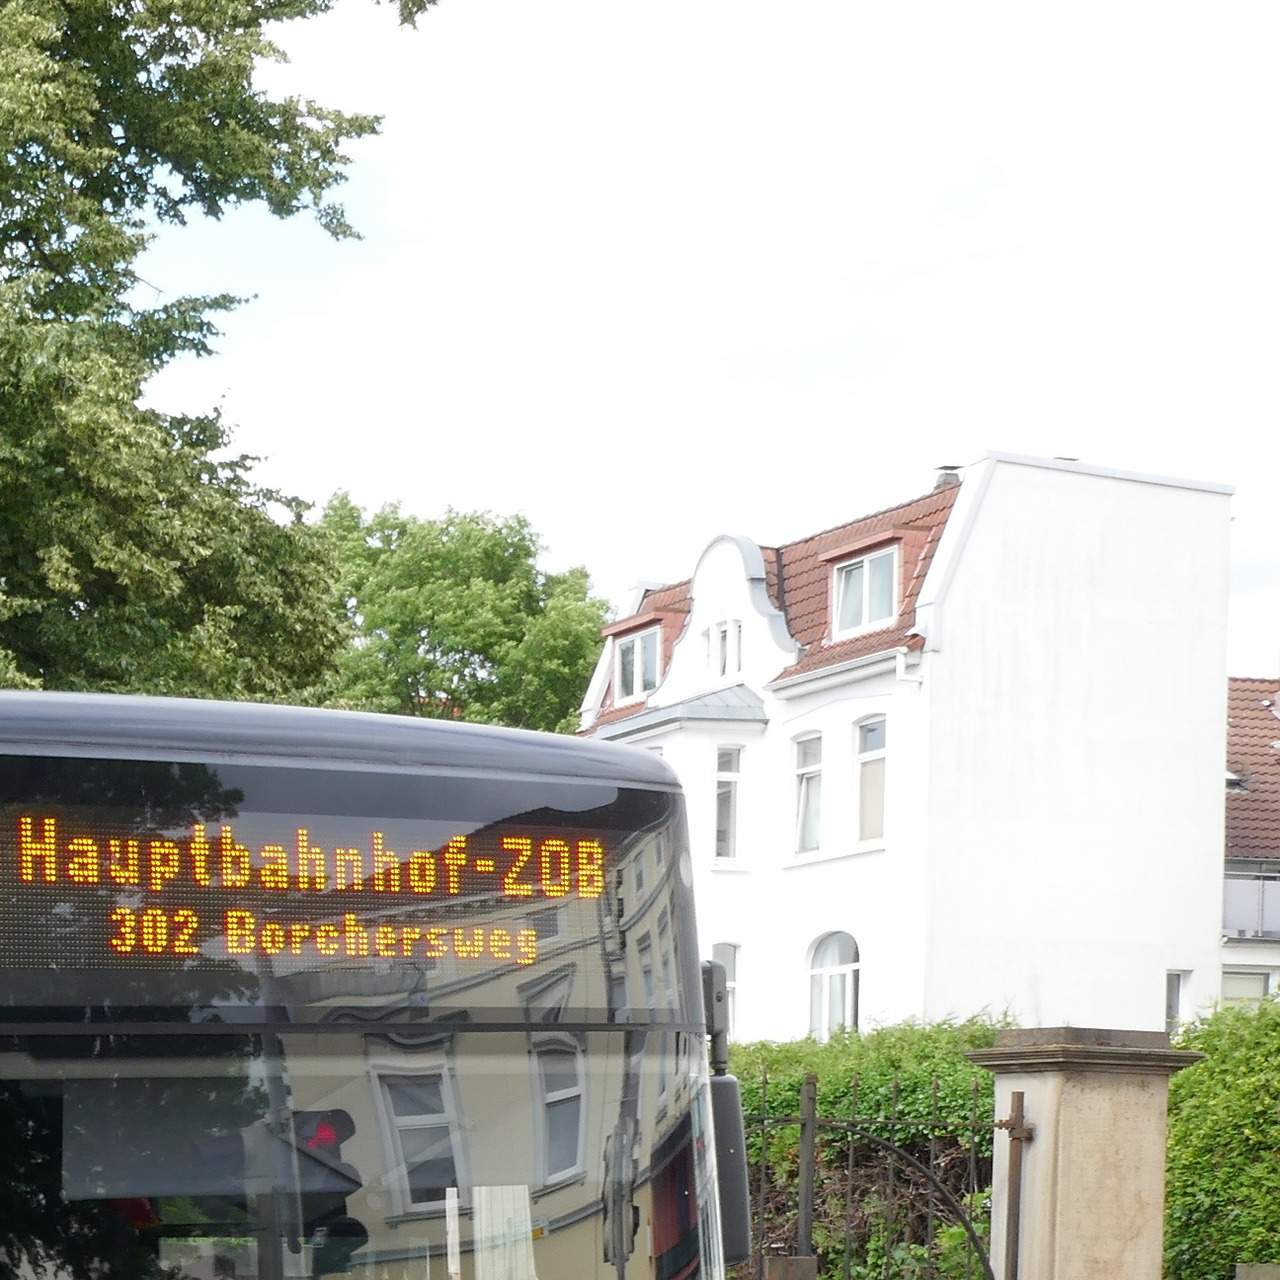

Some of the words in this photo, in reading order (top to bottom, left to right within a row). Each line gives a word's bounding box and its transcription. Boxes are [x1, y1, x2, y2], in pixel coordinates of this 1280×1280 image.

[19, 816, 605, 899] Hauptbahnhof-ZOB
[110, 907, 200, 954] 302
[226, 910, 538, 965] Borchersweg
